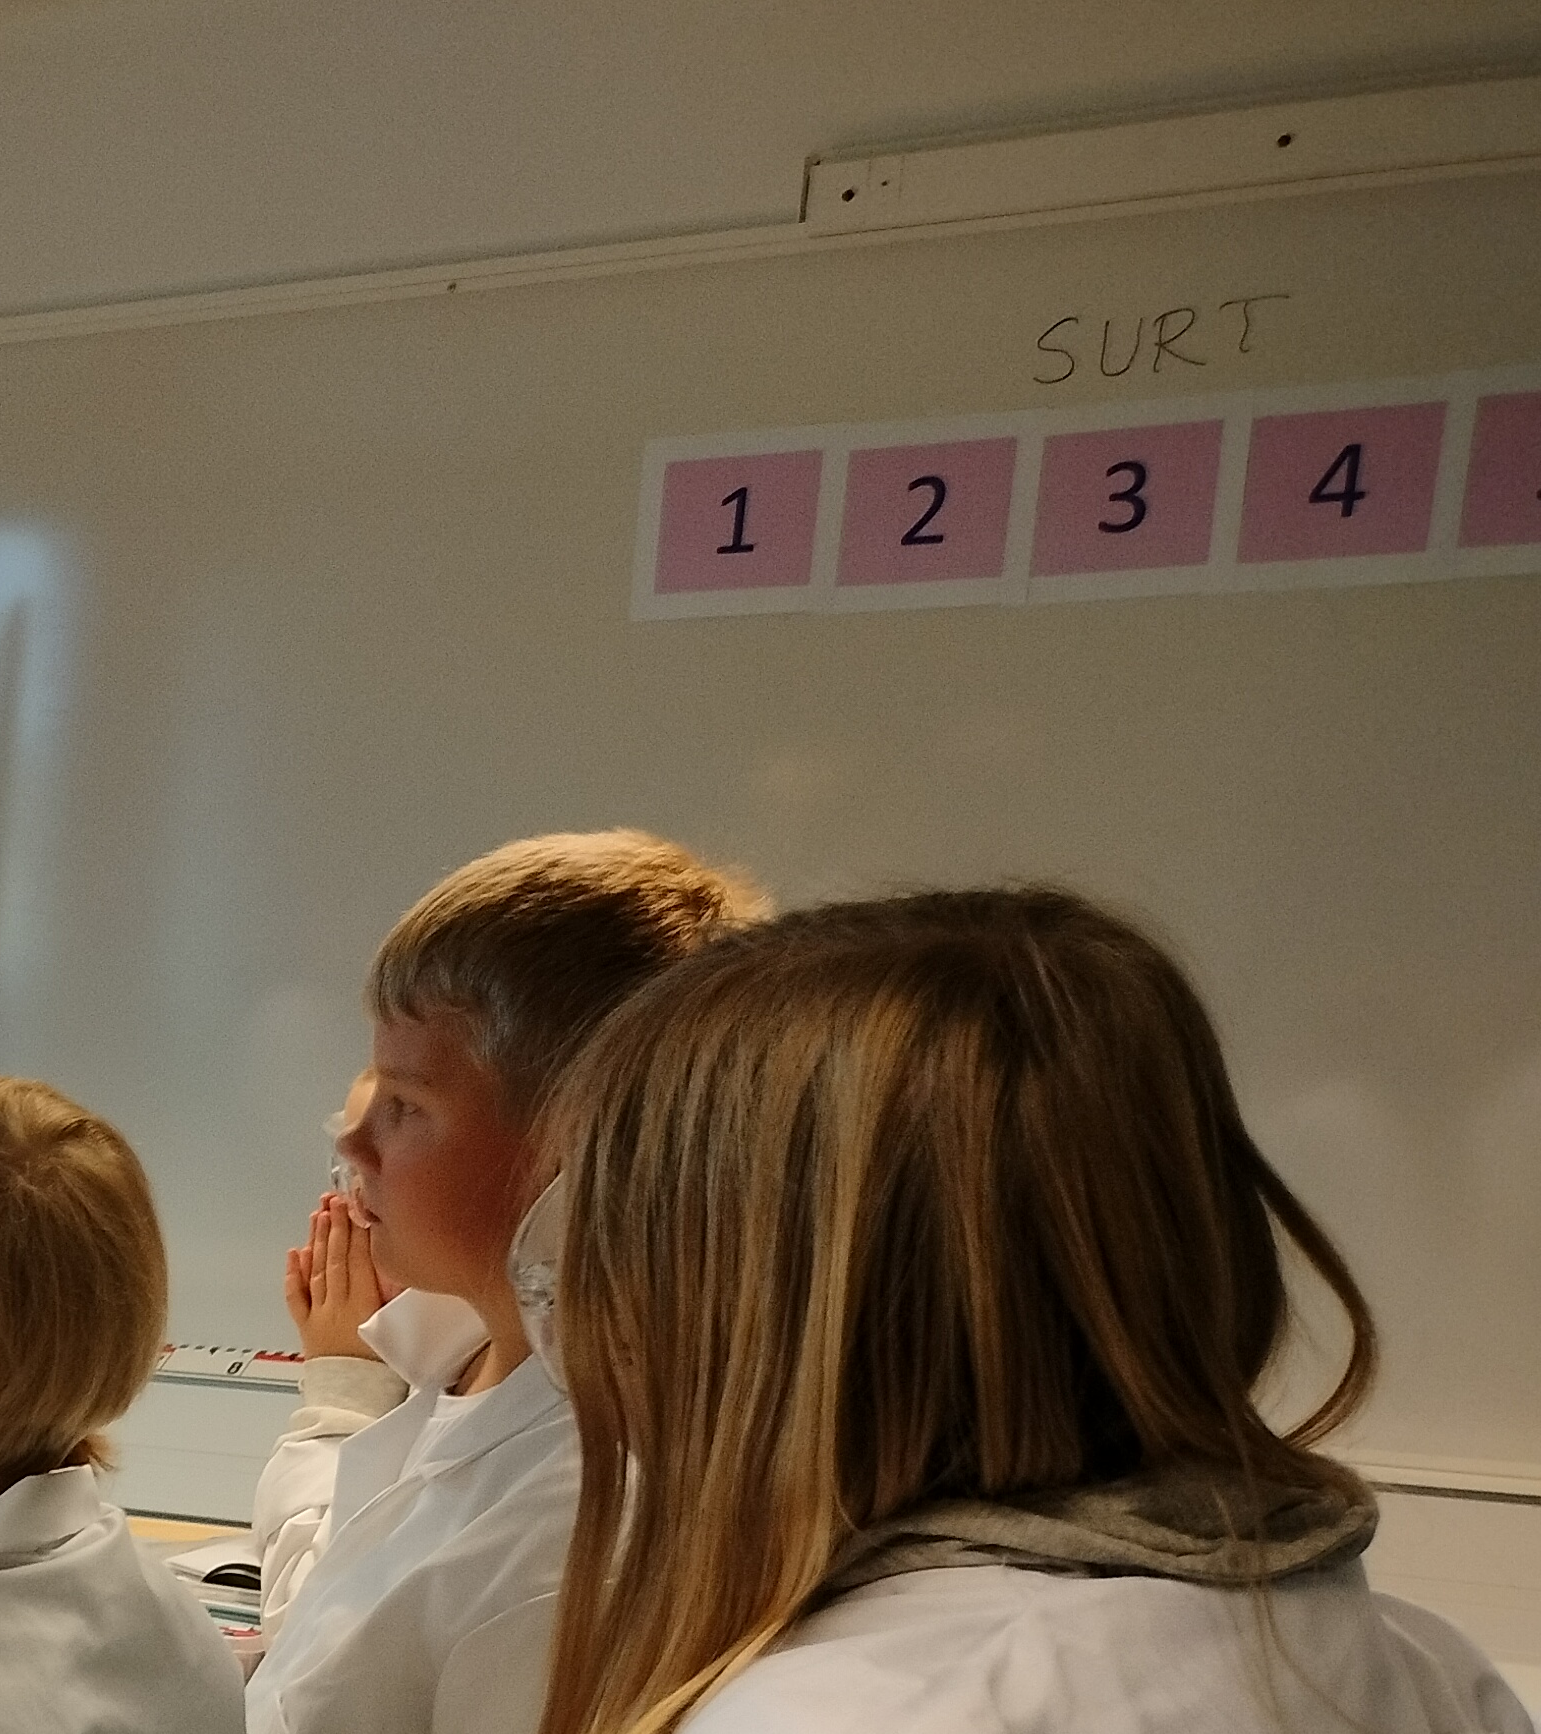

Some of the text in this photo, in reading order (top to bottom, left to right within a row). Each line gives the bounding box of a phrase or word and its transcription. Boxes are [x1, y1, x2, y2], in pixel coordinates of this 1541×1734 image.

[1032, 293, 1291, 385] SURT
[716, 443, 1366, 555] 1 2 3 4
